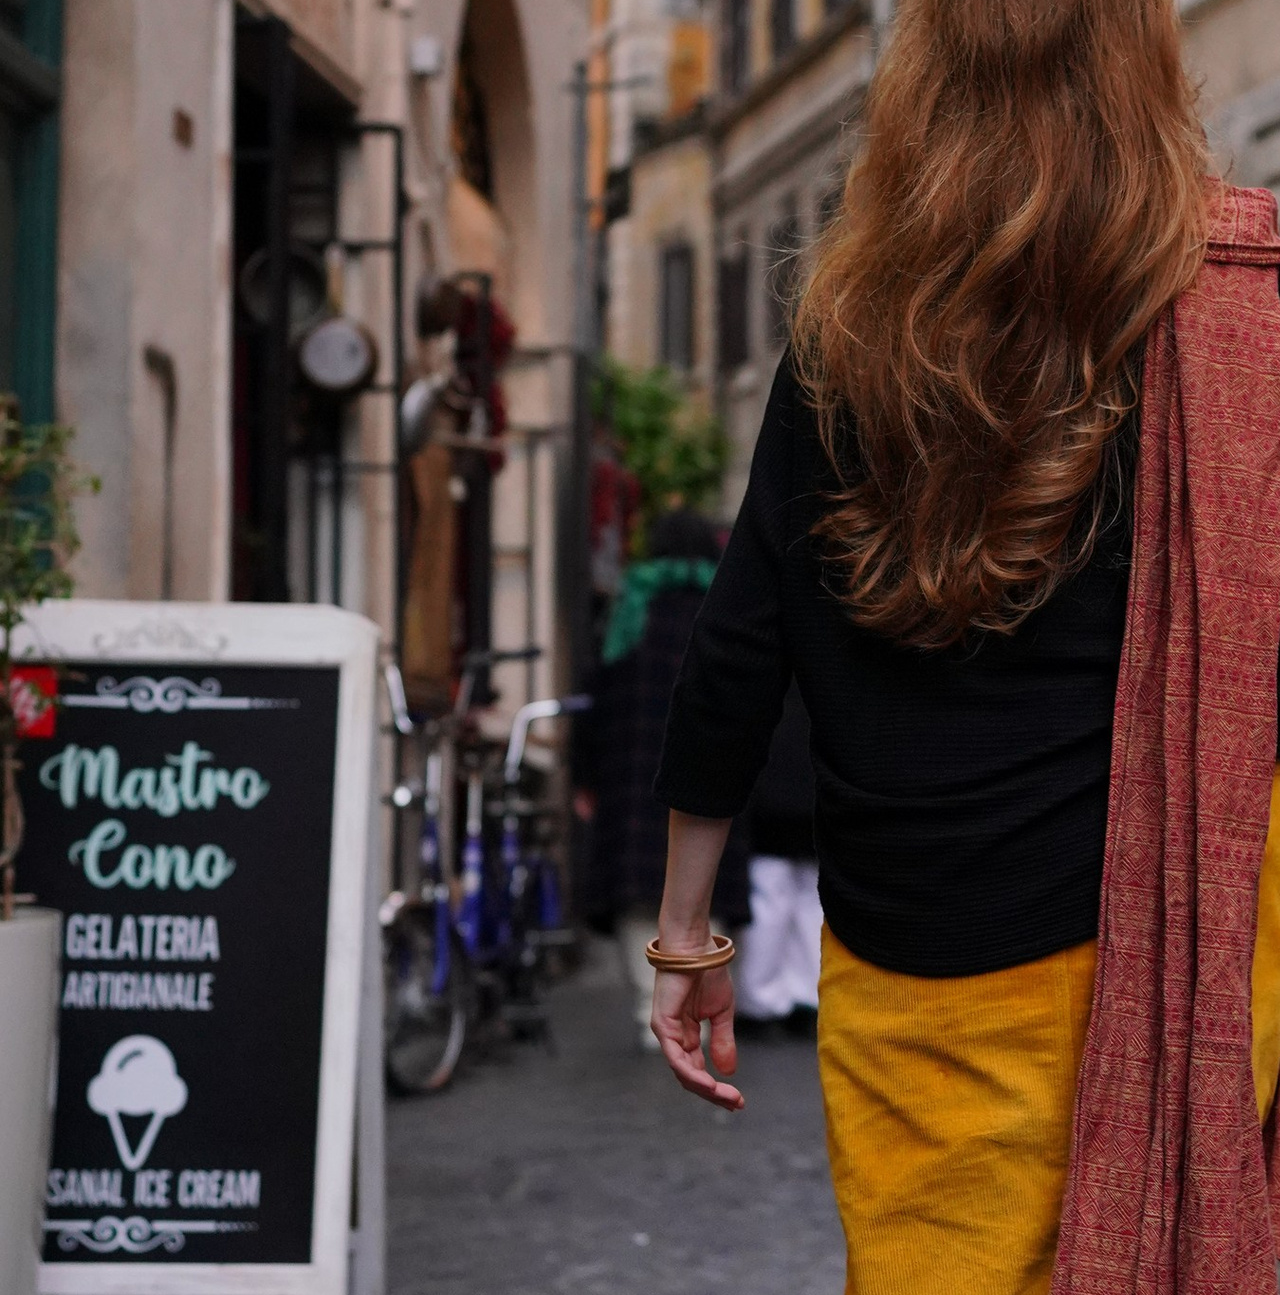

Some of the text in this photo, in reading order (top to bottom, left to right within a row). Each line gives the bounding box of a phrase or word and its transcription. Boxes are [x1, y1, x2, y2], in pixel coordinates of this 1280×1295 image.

[39, 740, 270, 817] Mastro
[67, 818, 236, 890] Cono
[66, 914, 220, 962] GELATERIA
[63, 971, 214, 1011] ARTIGIANALE
[133, 1169, 173, 1207] ICE
[178, 1169, 261, 1208] CREAM
